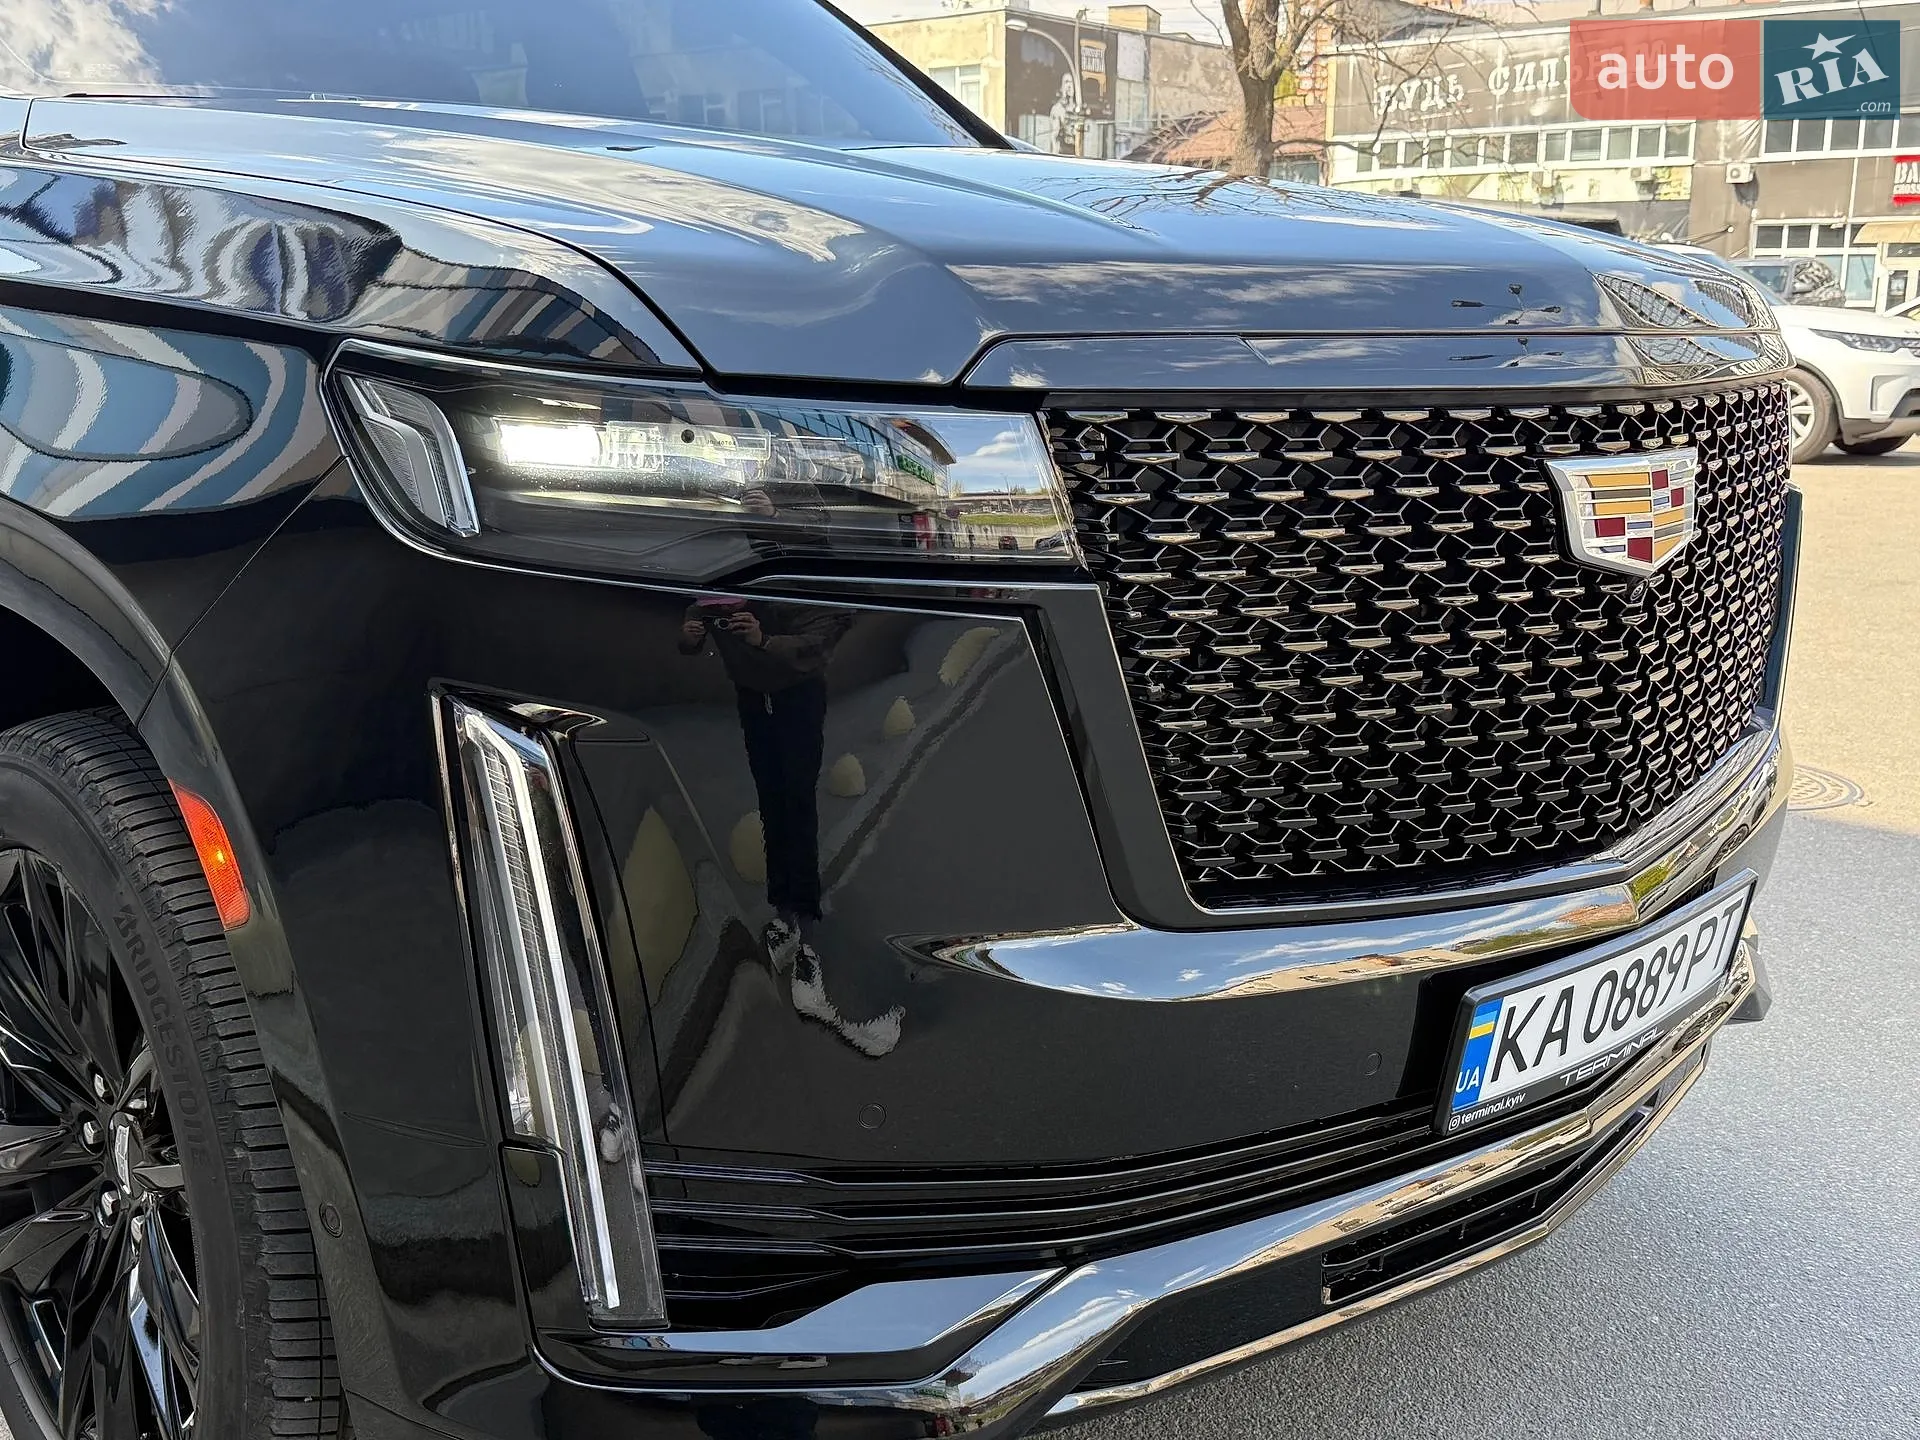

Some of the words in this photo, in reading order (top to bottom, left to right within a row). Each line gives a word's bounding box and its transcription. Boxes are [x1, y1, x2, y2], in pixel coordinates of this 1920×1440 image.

[1490, 985, 1575, 1083] KA
[1583, 934, 1688, 1044] 0889
[1456, 1066, 1480, 1093] UA
[1559, 1027, 1665, 1087] TERMINAL
